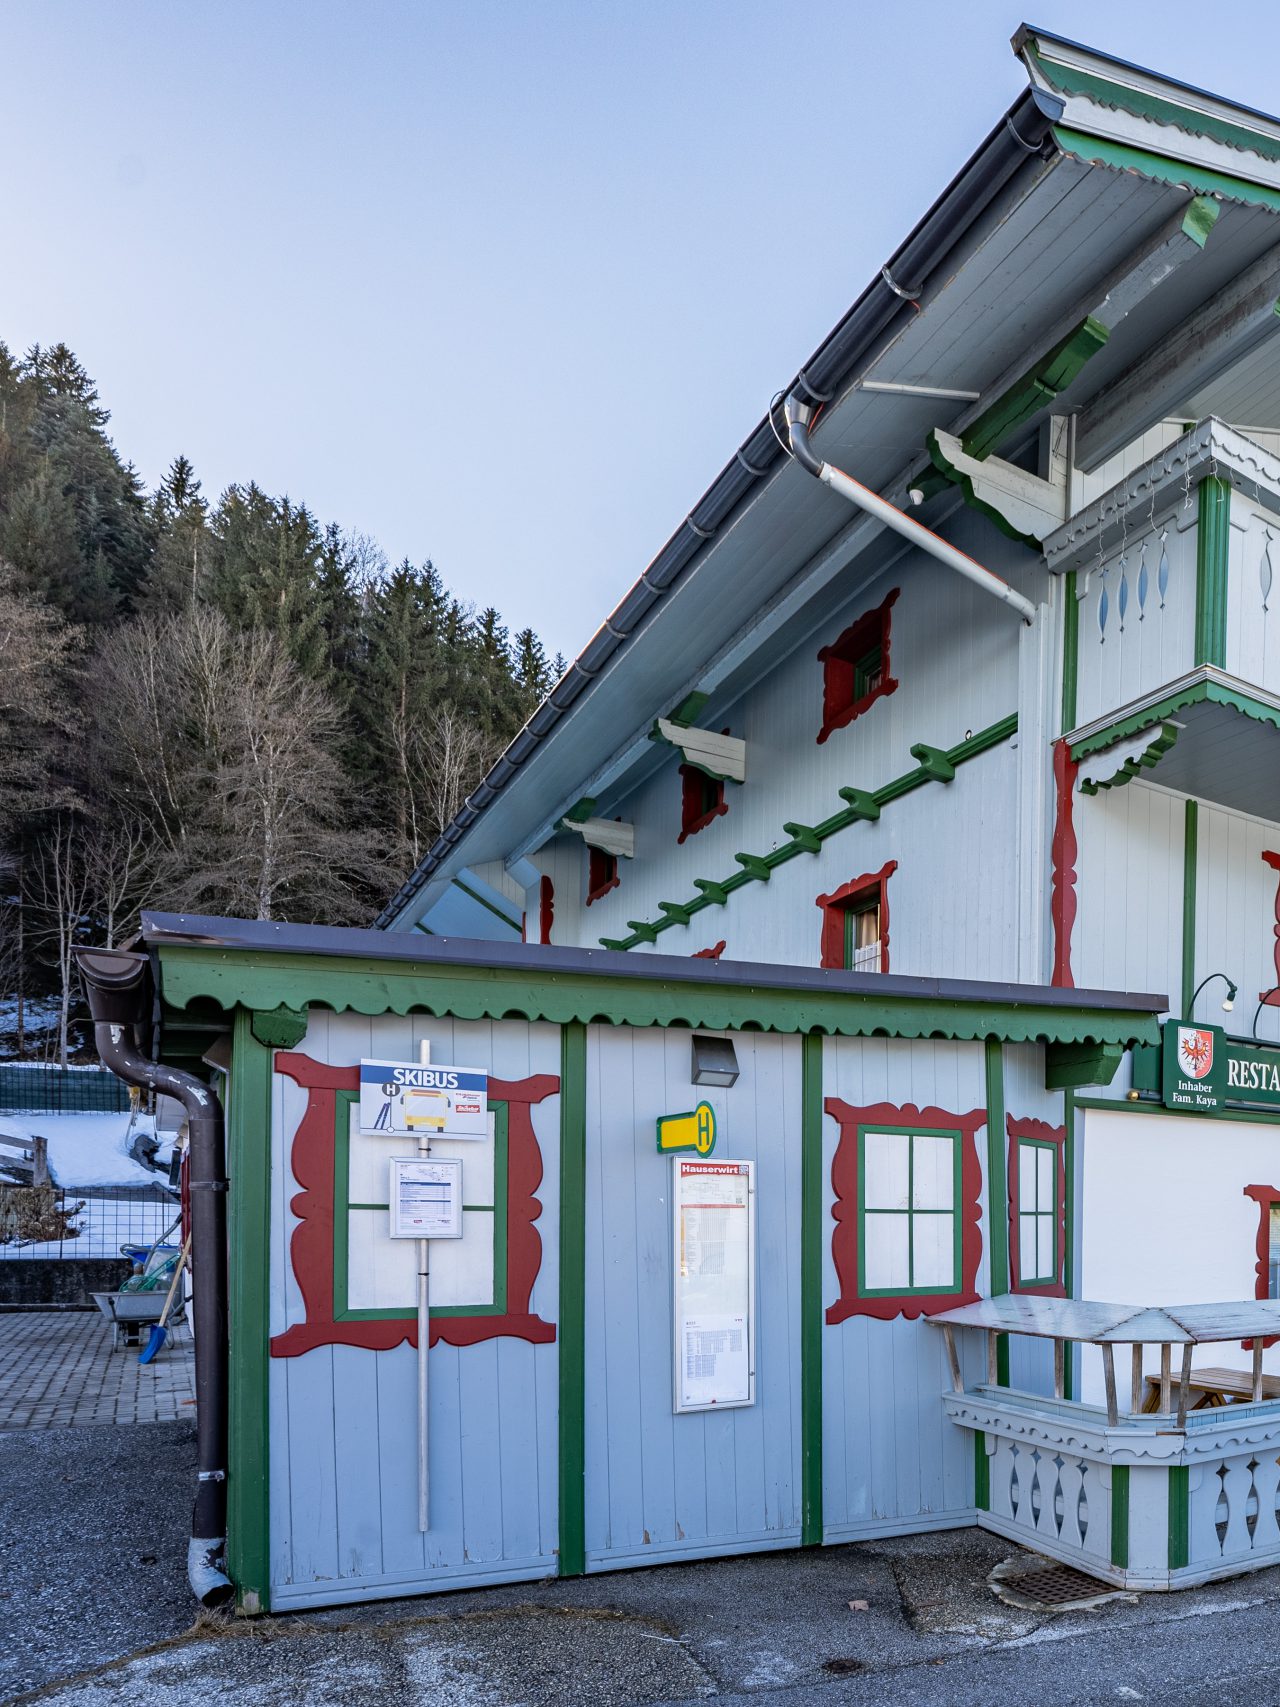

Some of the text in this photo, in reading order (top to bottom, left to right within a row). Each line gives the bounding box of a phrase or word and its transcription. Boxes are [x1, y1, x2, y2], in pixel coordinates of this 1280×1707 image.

[393, 1068, 459, 1089] SKIBUS
[386, 1084, 396, 1096] H
[1178, 1080, 1213, 1093] Inhaber
[1172, 1092, 1217, 1107] Fam. Kaya
[698, 1112, 709, 1147] H
[682, 1164, 738, 1174] Hauserwirt
